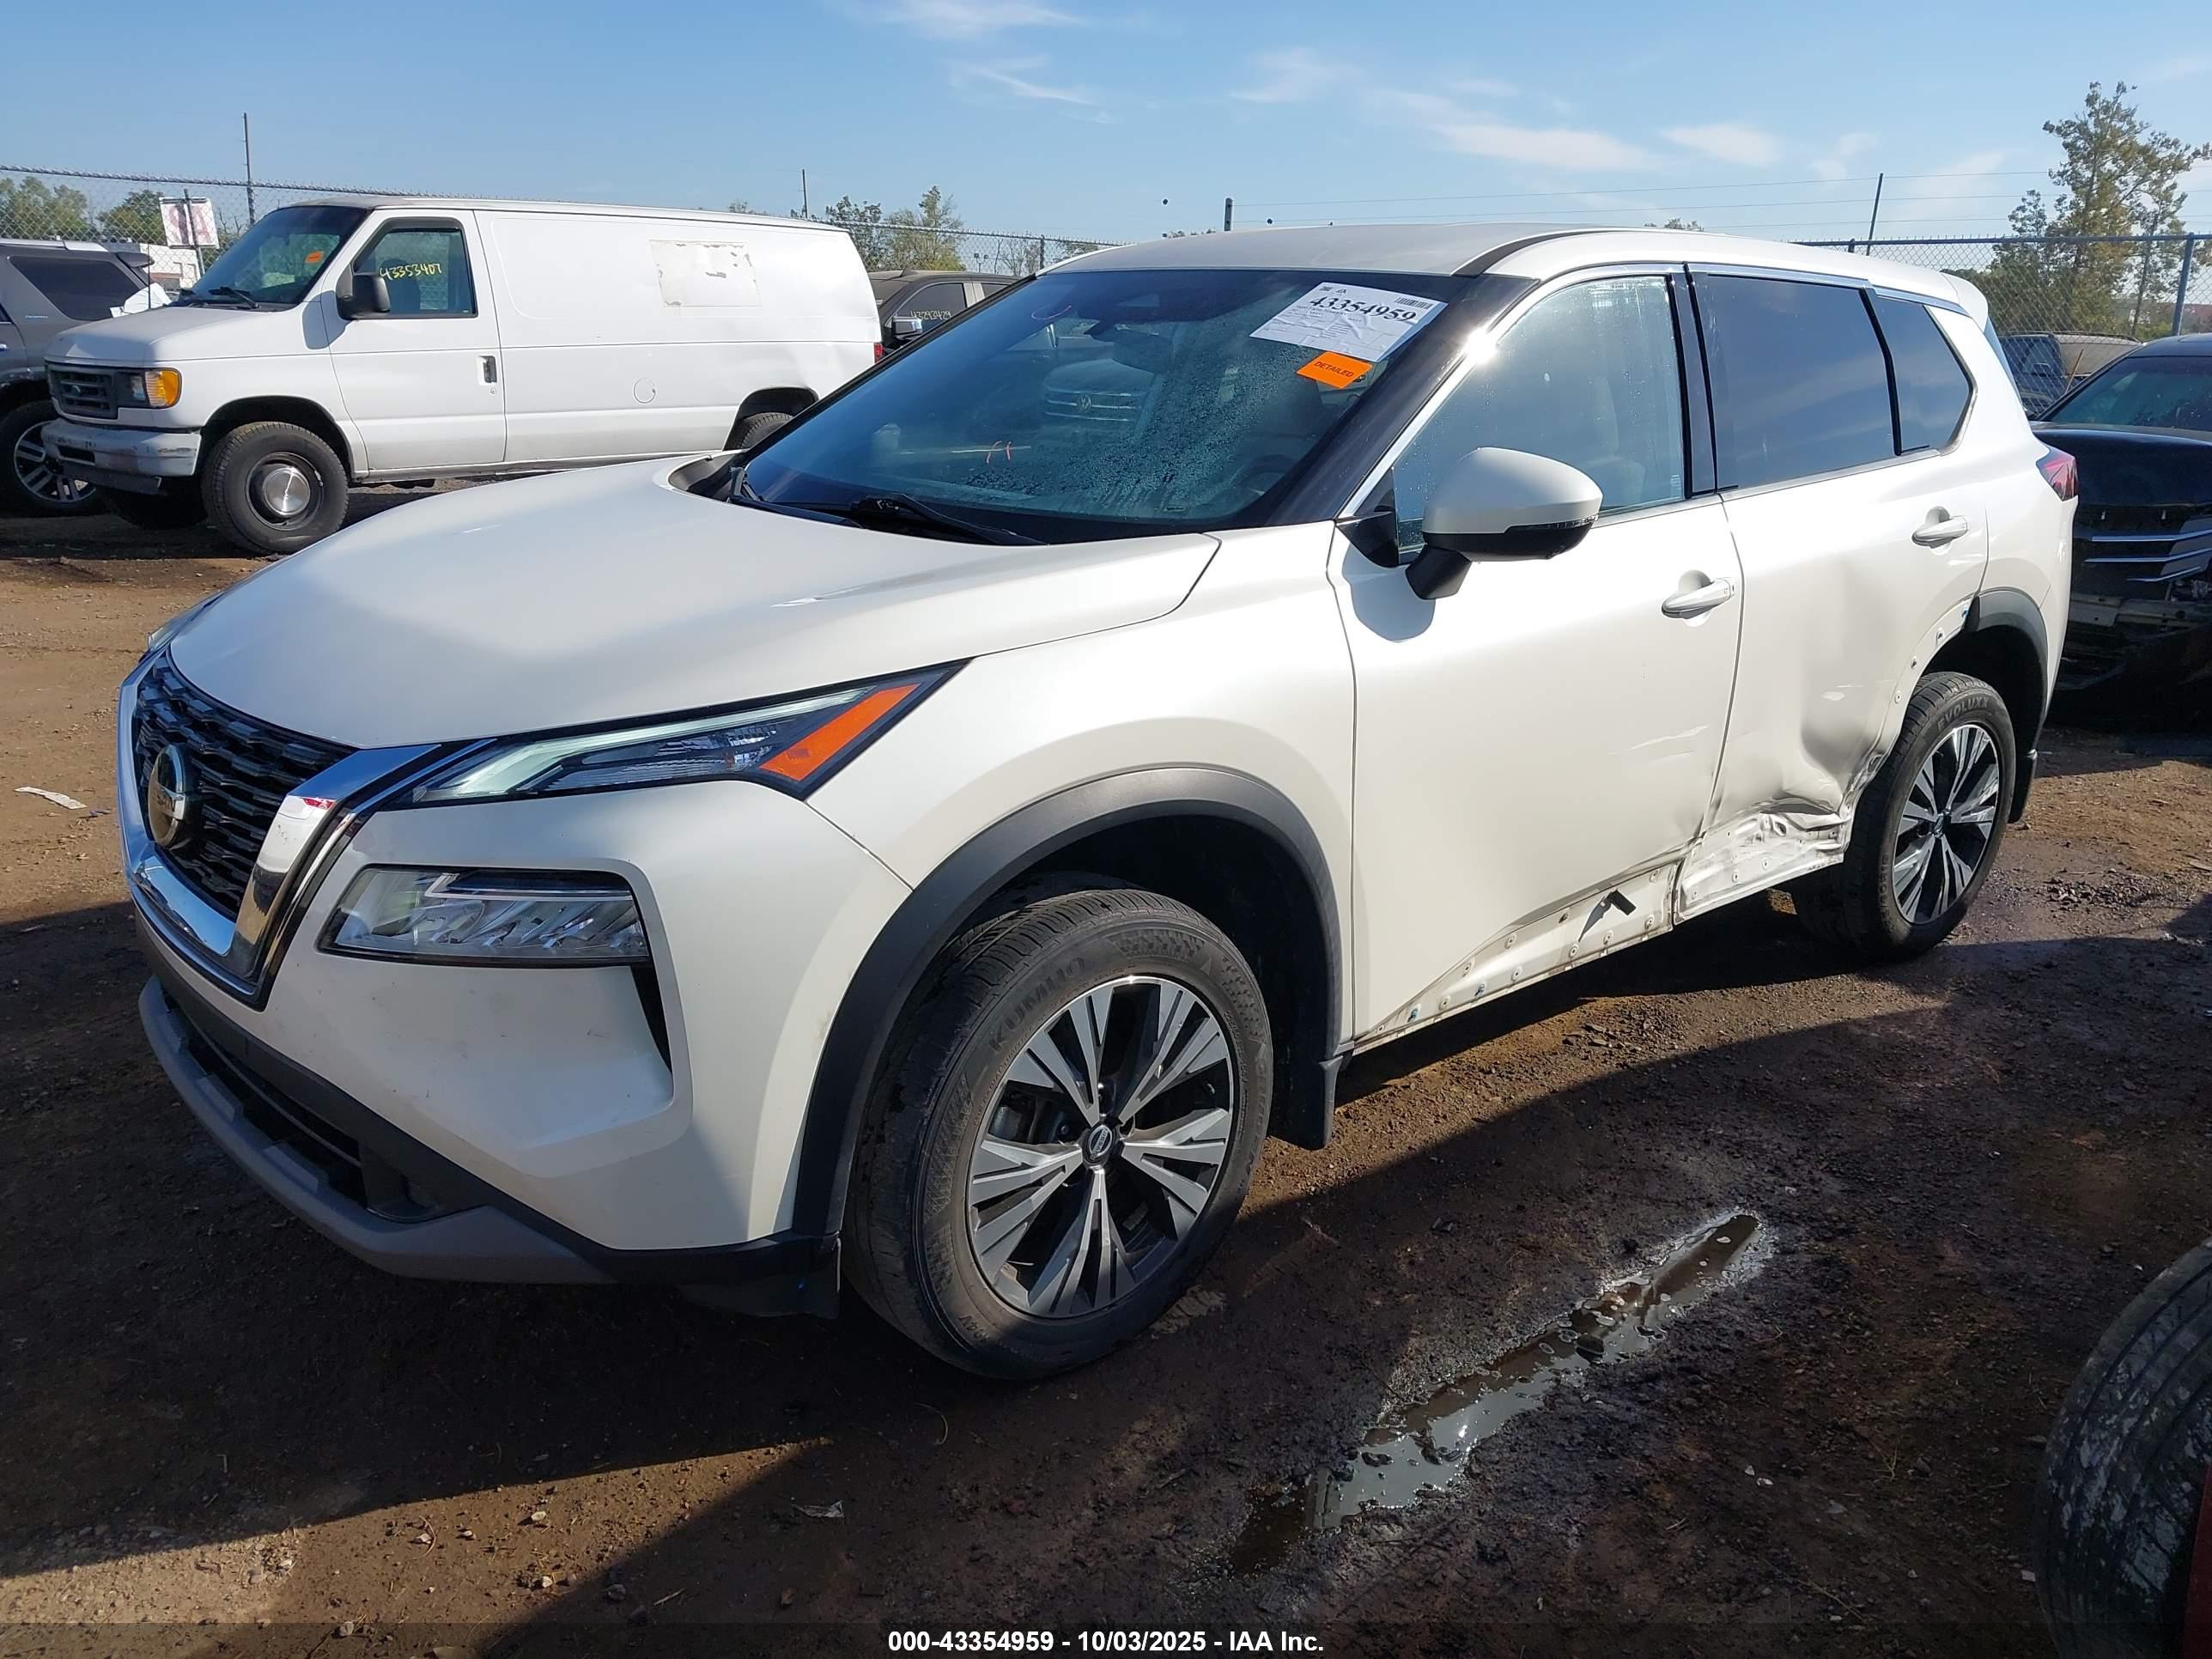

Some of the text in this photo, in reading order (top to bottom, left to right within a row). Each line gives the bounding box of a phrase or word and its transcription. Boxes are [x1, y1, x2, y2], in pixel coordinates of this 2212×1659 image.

[379, 263, 442, 281] 43353407
[1309, 296, 1417, 322] 43354959
[1313, 360, 1354, 378] DETAILED
